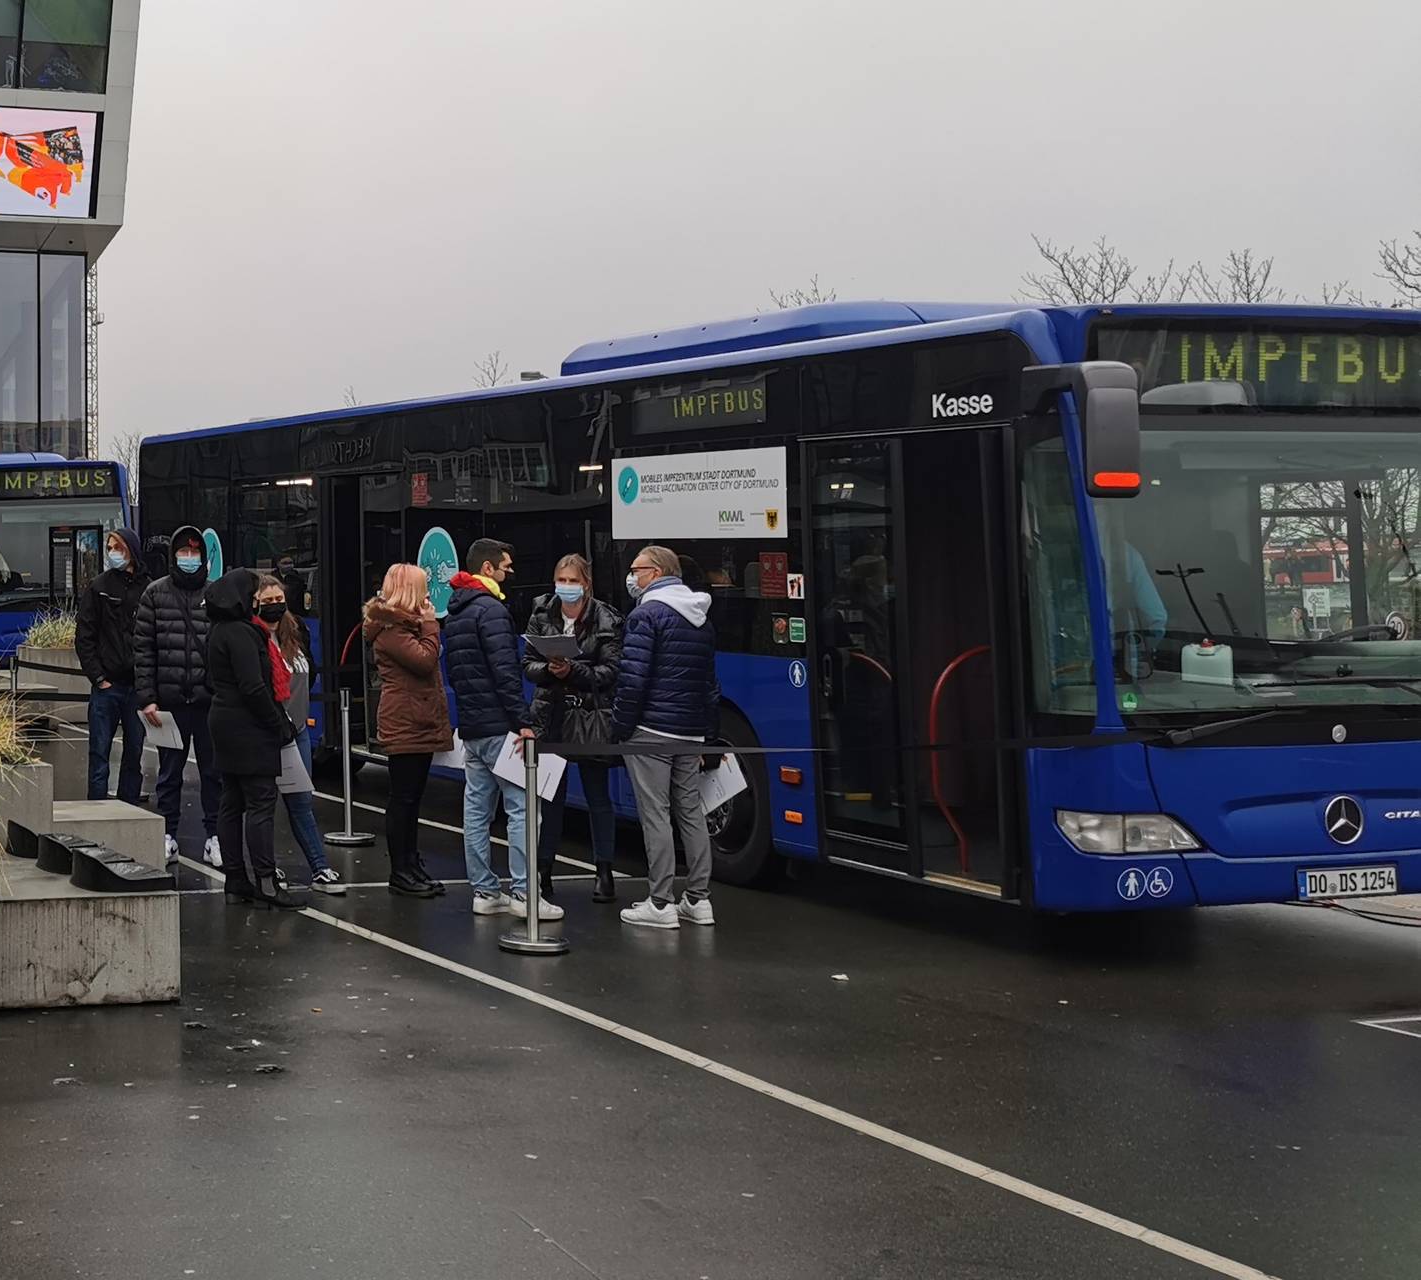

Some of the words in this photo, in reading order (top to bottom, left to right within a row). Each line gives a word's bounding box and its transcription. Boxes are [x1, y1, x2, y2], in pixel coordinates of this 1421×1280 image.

[672, 388, 764, 418] IMPFBUS
[931, 392, 994, 418] Kasse
[640, 473, 663, 483] MOBILES
[664, 471, 702, 482] IMPFZENTRUM
[703, 470, 721, 480] STADT
[721, 468, 756, 479] DORTMUND
[640, 484, 660, 493] MOBILE
[661, 482, 697, 492] VACCINATION
[698, 481, 719, 491] CENTER
[720, 480, 733, 490] CITY
[733, 480, 742, 489] OF
[743, 478, 779, 489] DORTMUND
[1308, 873, 1327, 894] DO
[1339, 872, 1357, 893] DS
[1361, 870, 1394, 891] 1254
